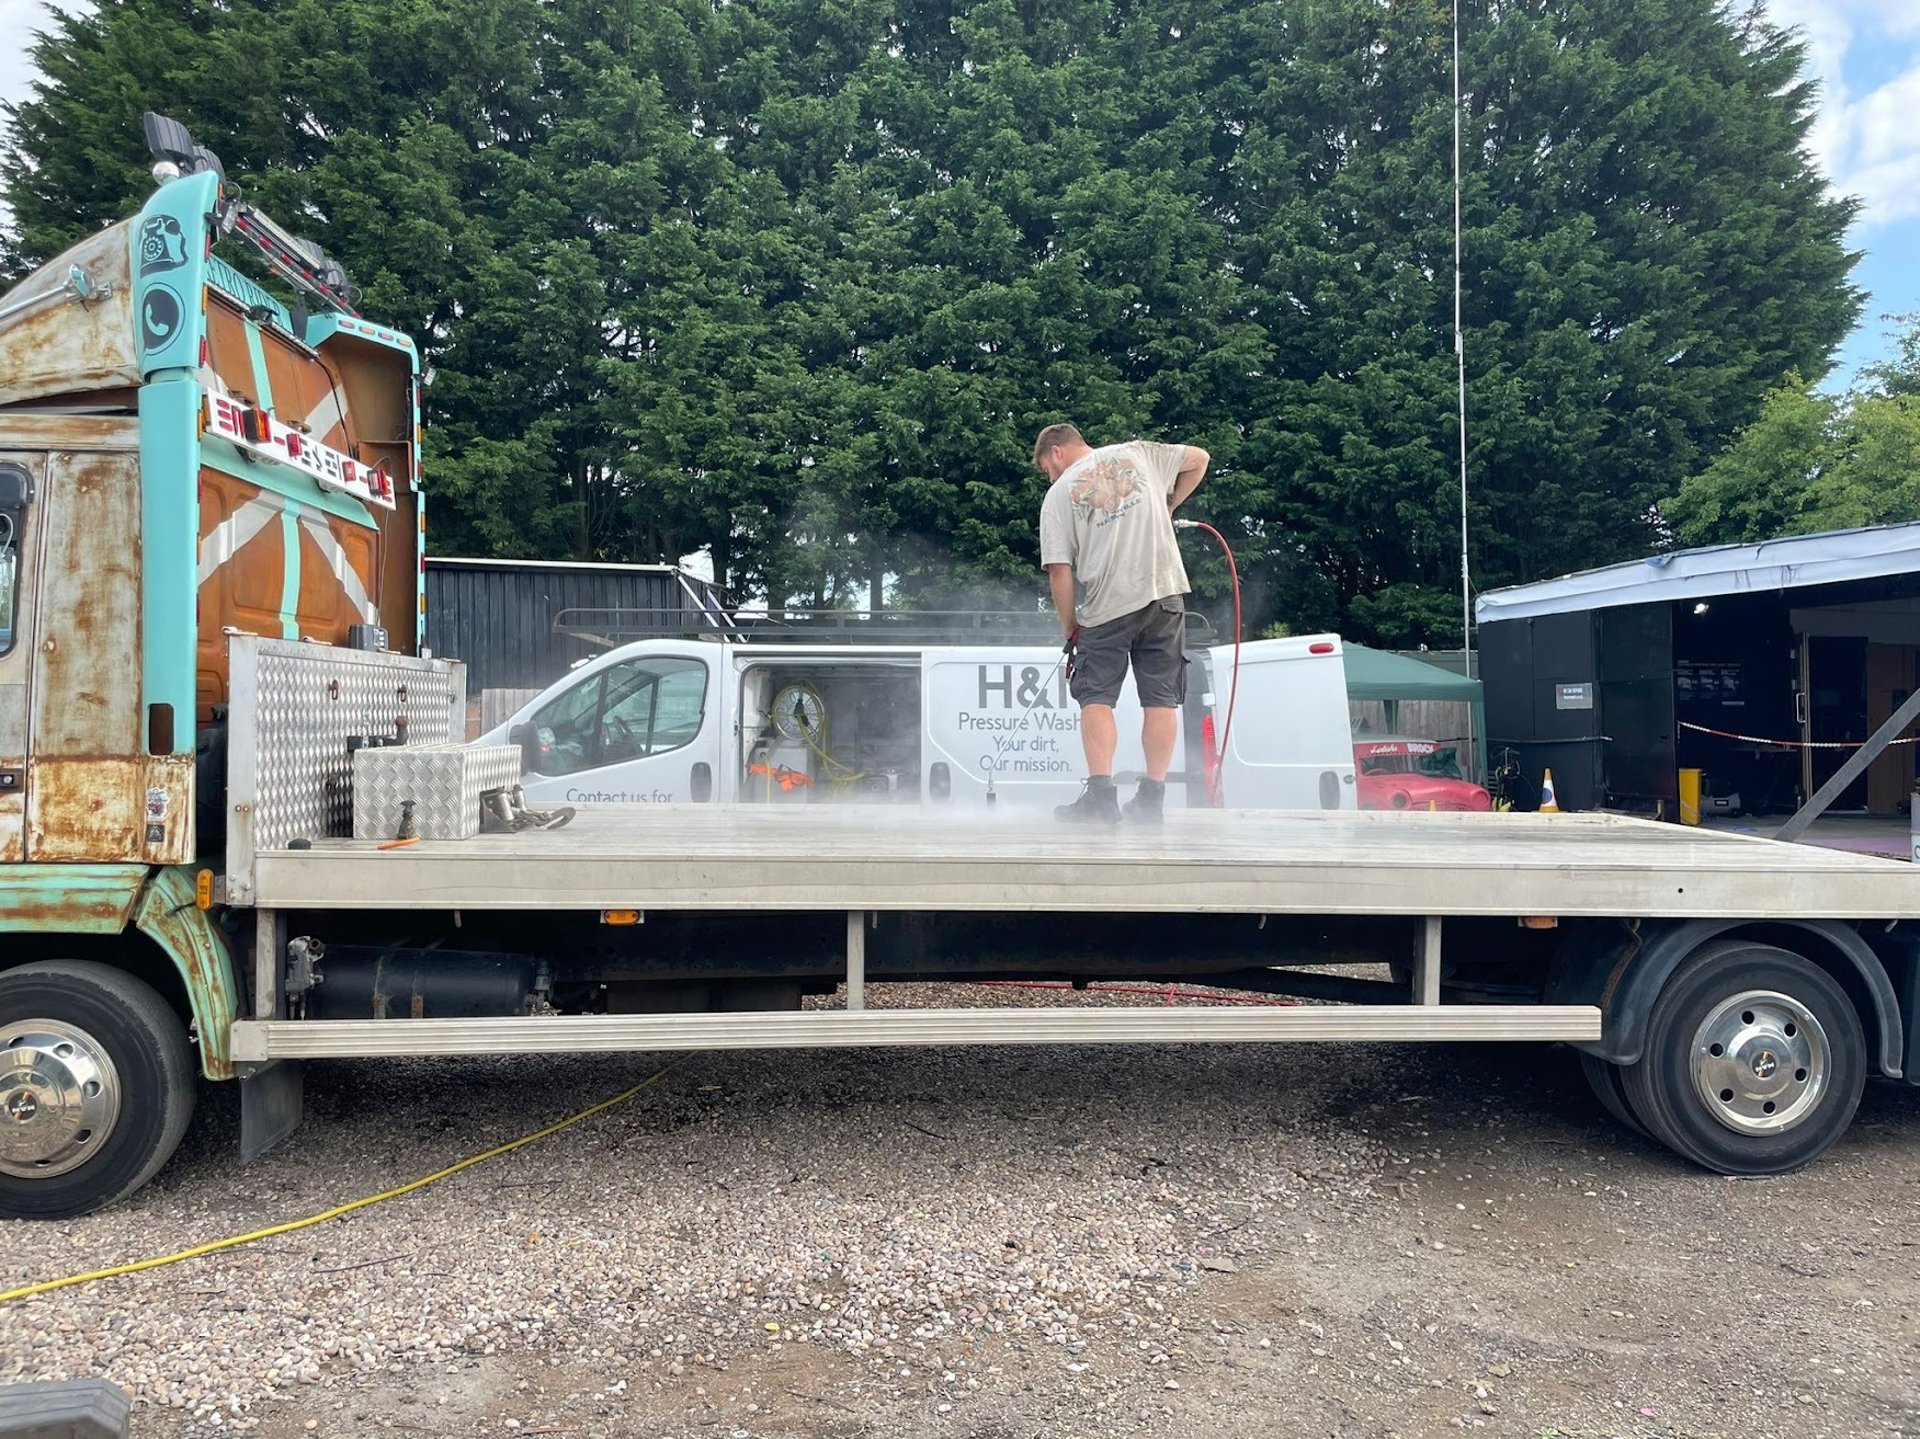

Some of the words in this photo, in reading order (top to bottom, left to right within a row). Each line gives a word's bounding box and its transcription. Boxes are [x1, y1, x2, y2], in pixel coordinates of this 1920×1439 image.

[959, 712, 1029, 731] Pressure
[993, 736, 1028, 752] Your
[1031, 736, 1059, 753] dirt,
[980, 755, 1009, 772] Our
[1015, 756, 1073, 772] mission.
[567, 788, 626, 802] Contact
[631, 793, 648, 802] us
[651, 788, 674, 802] for
